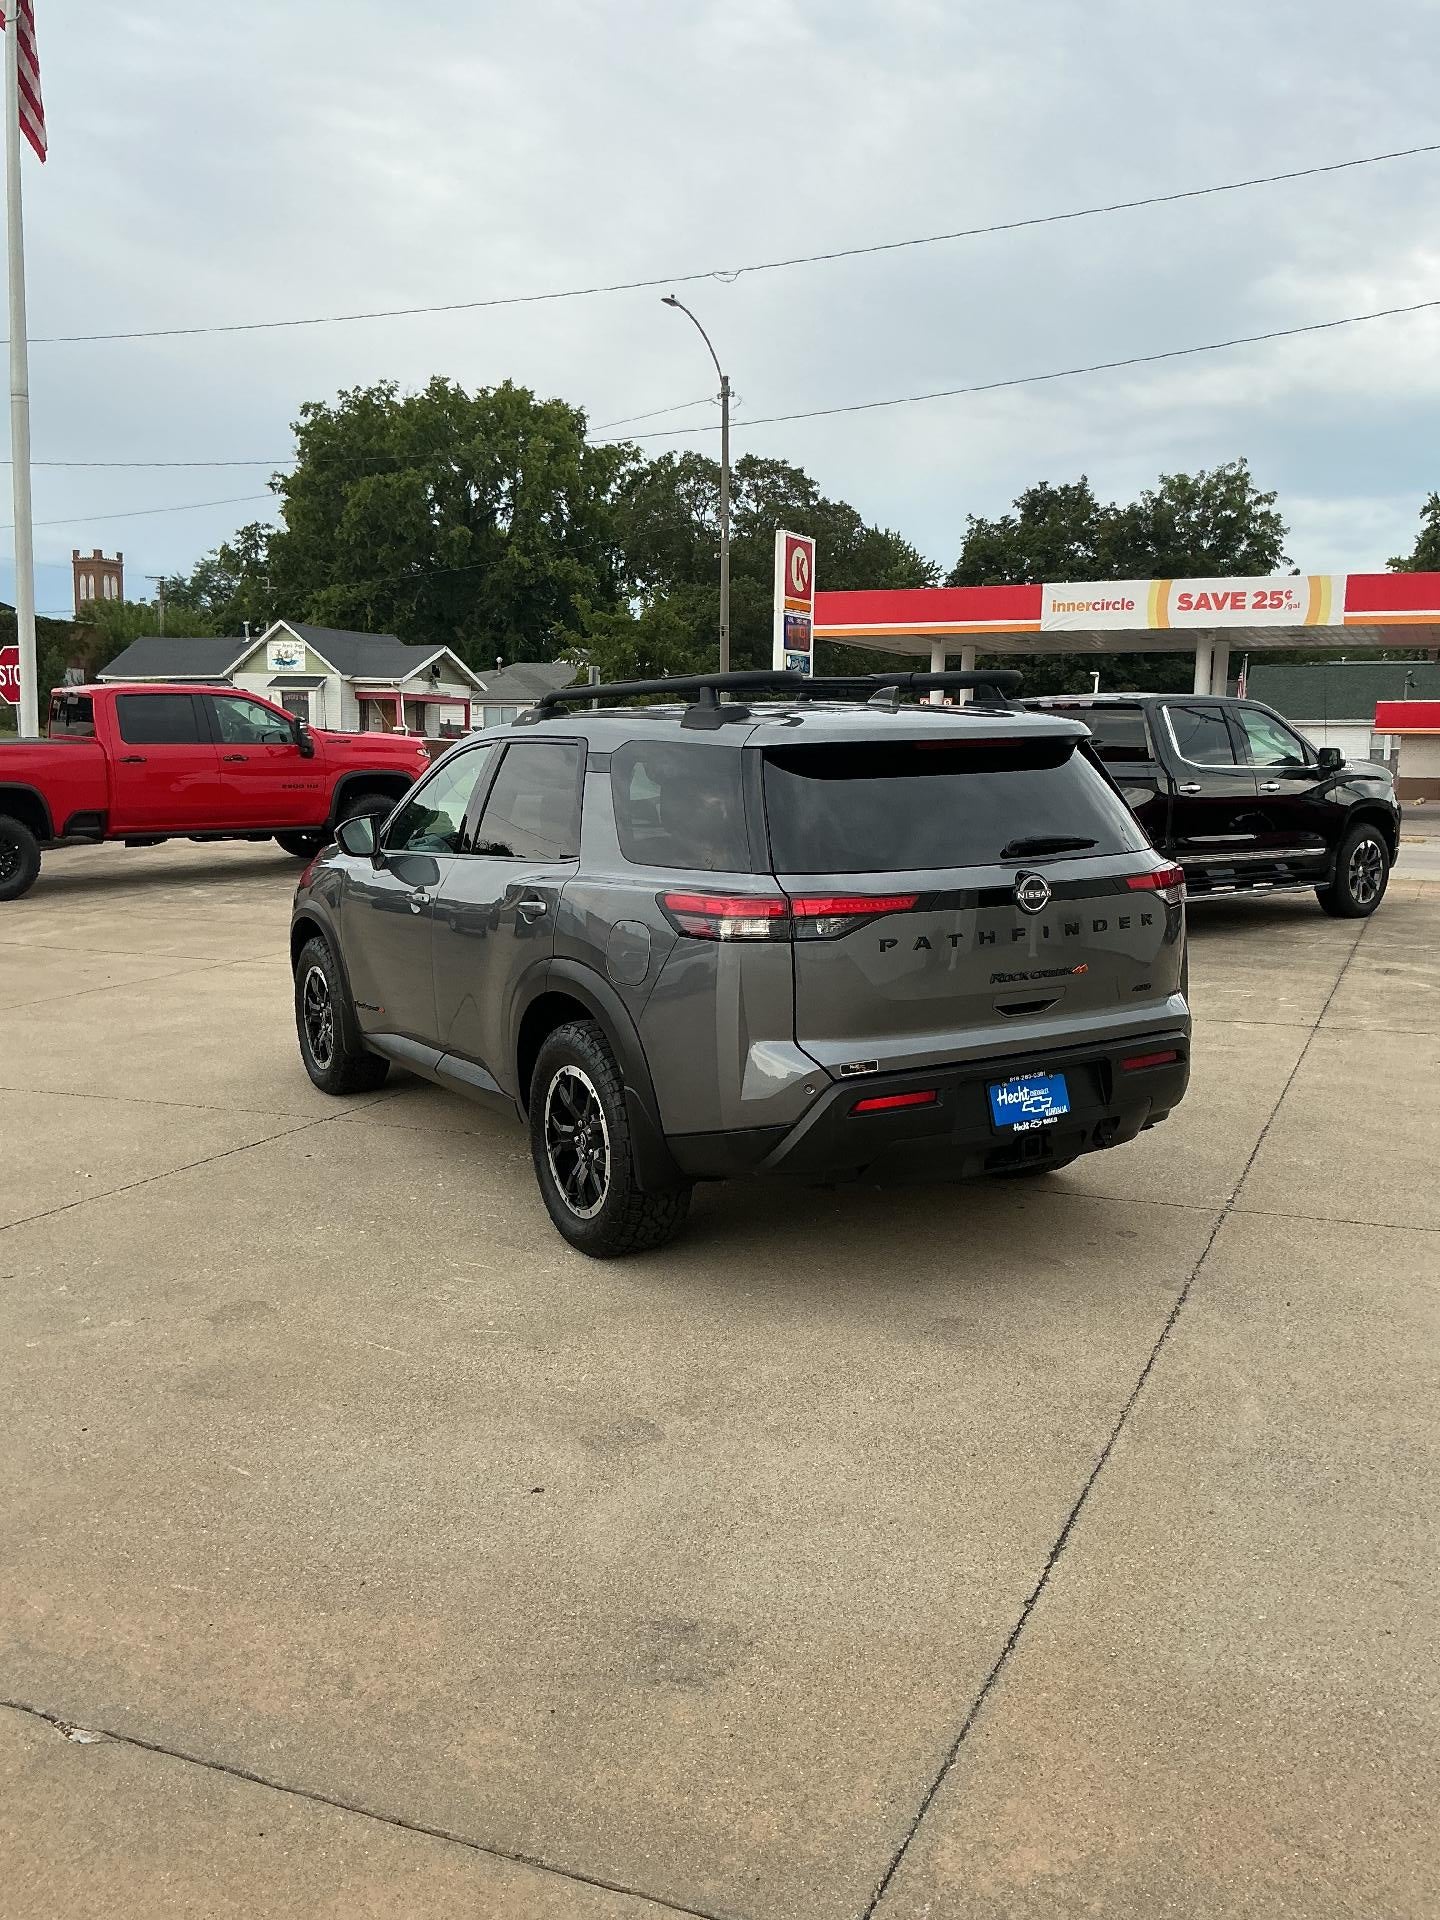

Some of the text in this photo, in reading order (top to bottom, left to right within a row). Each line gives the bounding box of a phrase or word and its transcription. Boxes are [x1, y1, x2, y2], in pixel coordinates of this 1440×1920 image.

[1052, 598, 1135, 612] innercircle
[1177, 592, 1246, 611] SAVE
[1017, 890, 1051, 900] NISSAN
[879, 913, 1153, 953] PATHFINDER
[997, 1085, 1030, 1106] Hecht
